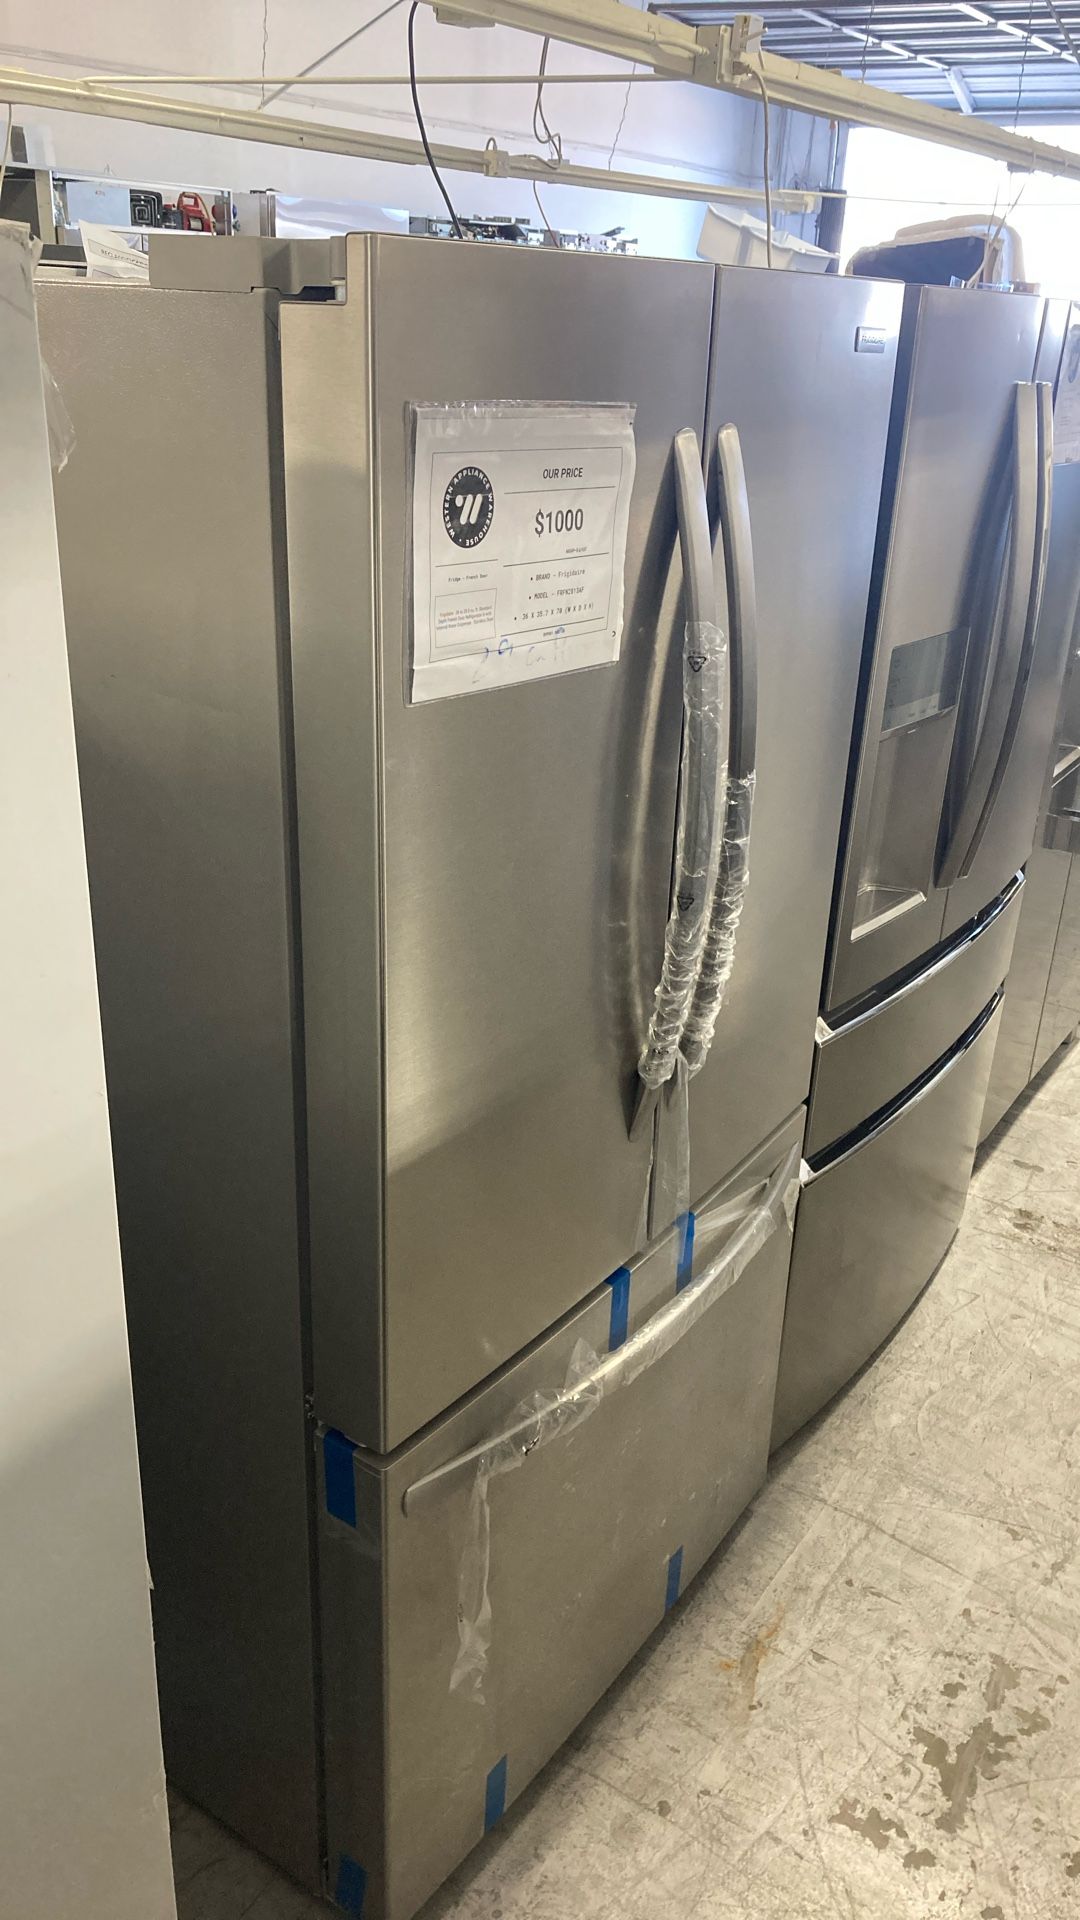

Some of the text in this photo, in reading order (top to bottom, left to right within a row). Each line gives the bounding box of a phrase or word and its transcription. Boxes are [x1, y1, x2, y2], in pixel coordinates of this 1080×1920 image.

[543, 467, 583, 479] OUR PRICE
[444, 468, 493, 546] WESTERN APPLIANCE WAREHOUSE
[535, 508, 584, 538] $1000
[536, 573, 551, 581] BRAND
[558, 569, 586, 578] Frigidaire
[534, 592, 548, 600] MODEL
